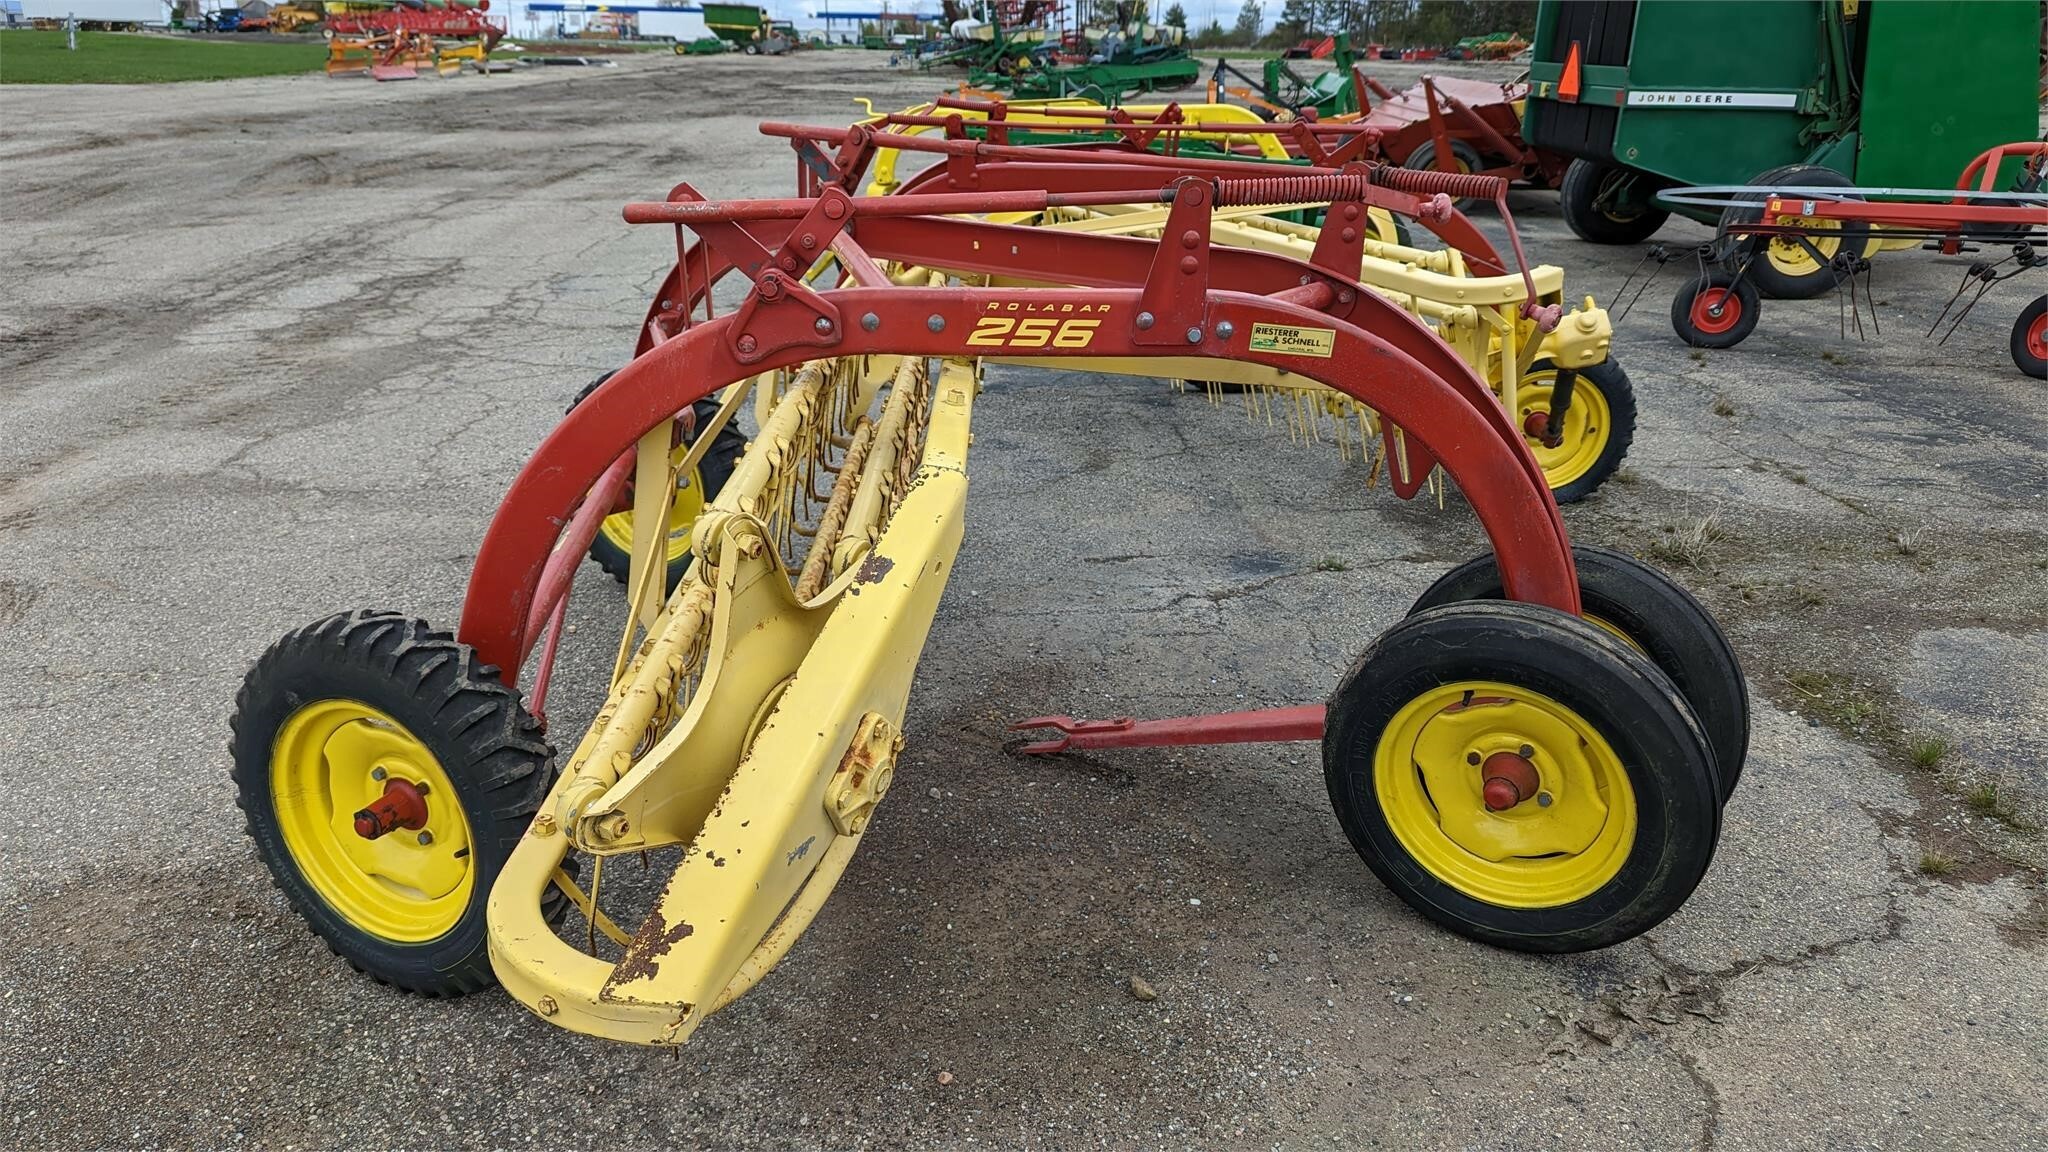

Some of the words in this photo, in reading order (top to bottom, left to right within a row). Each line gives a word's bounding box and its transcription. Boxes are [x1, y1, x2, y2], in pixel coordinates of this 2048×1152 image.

[1638, 94, 1676, 103] JOHN
[1684, 95, 1733, 104] DEERE
[986, 302, 1111, 313] ROLABAR
[965, 317, 1102, 348] 256
[1255, 326, 1300, 338] RIESTERER
[1273, 336, 1279, 344] &
[1281, 337, 1321, 347] SCHNELL
